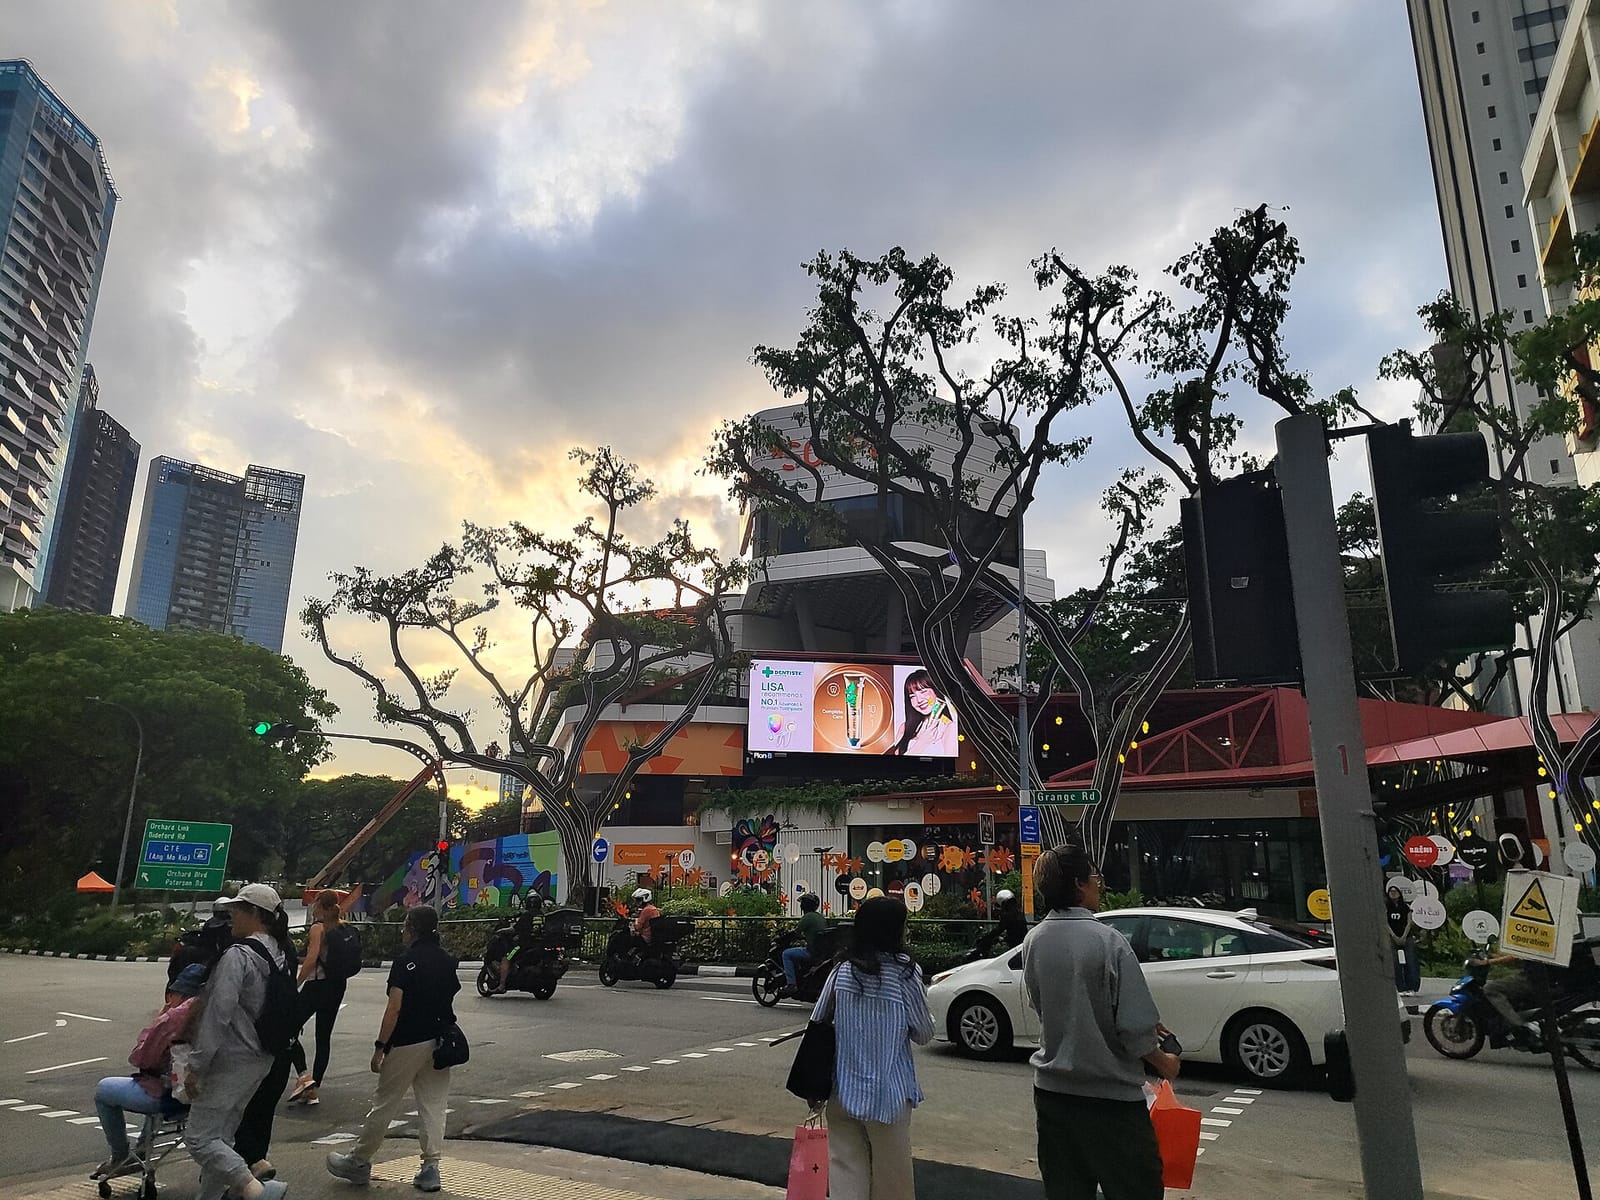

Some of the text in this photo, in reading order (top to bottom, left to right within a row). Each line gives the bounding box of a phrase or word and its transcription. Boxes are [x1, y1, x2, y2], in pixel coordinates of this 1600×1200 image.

[761, 682, 785, 692] LISA
[761, 698, 778, 706] NO.1
[1037, 791, 1095, 803] Grange Rd
[150, 822, 175, 830] Orchard
[166, 870, 191, 878] Orchard
[1515, 923, 1539, 935] CCTV
[1510, 934, 1550, 948] operation
